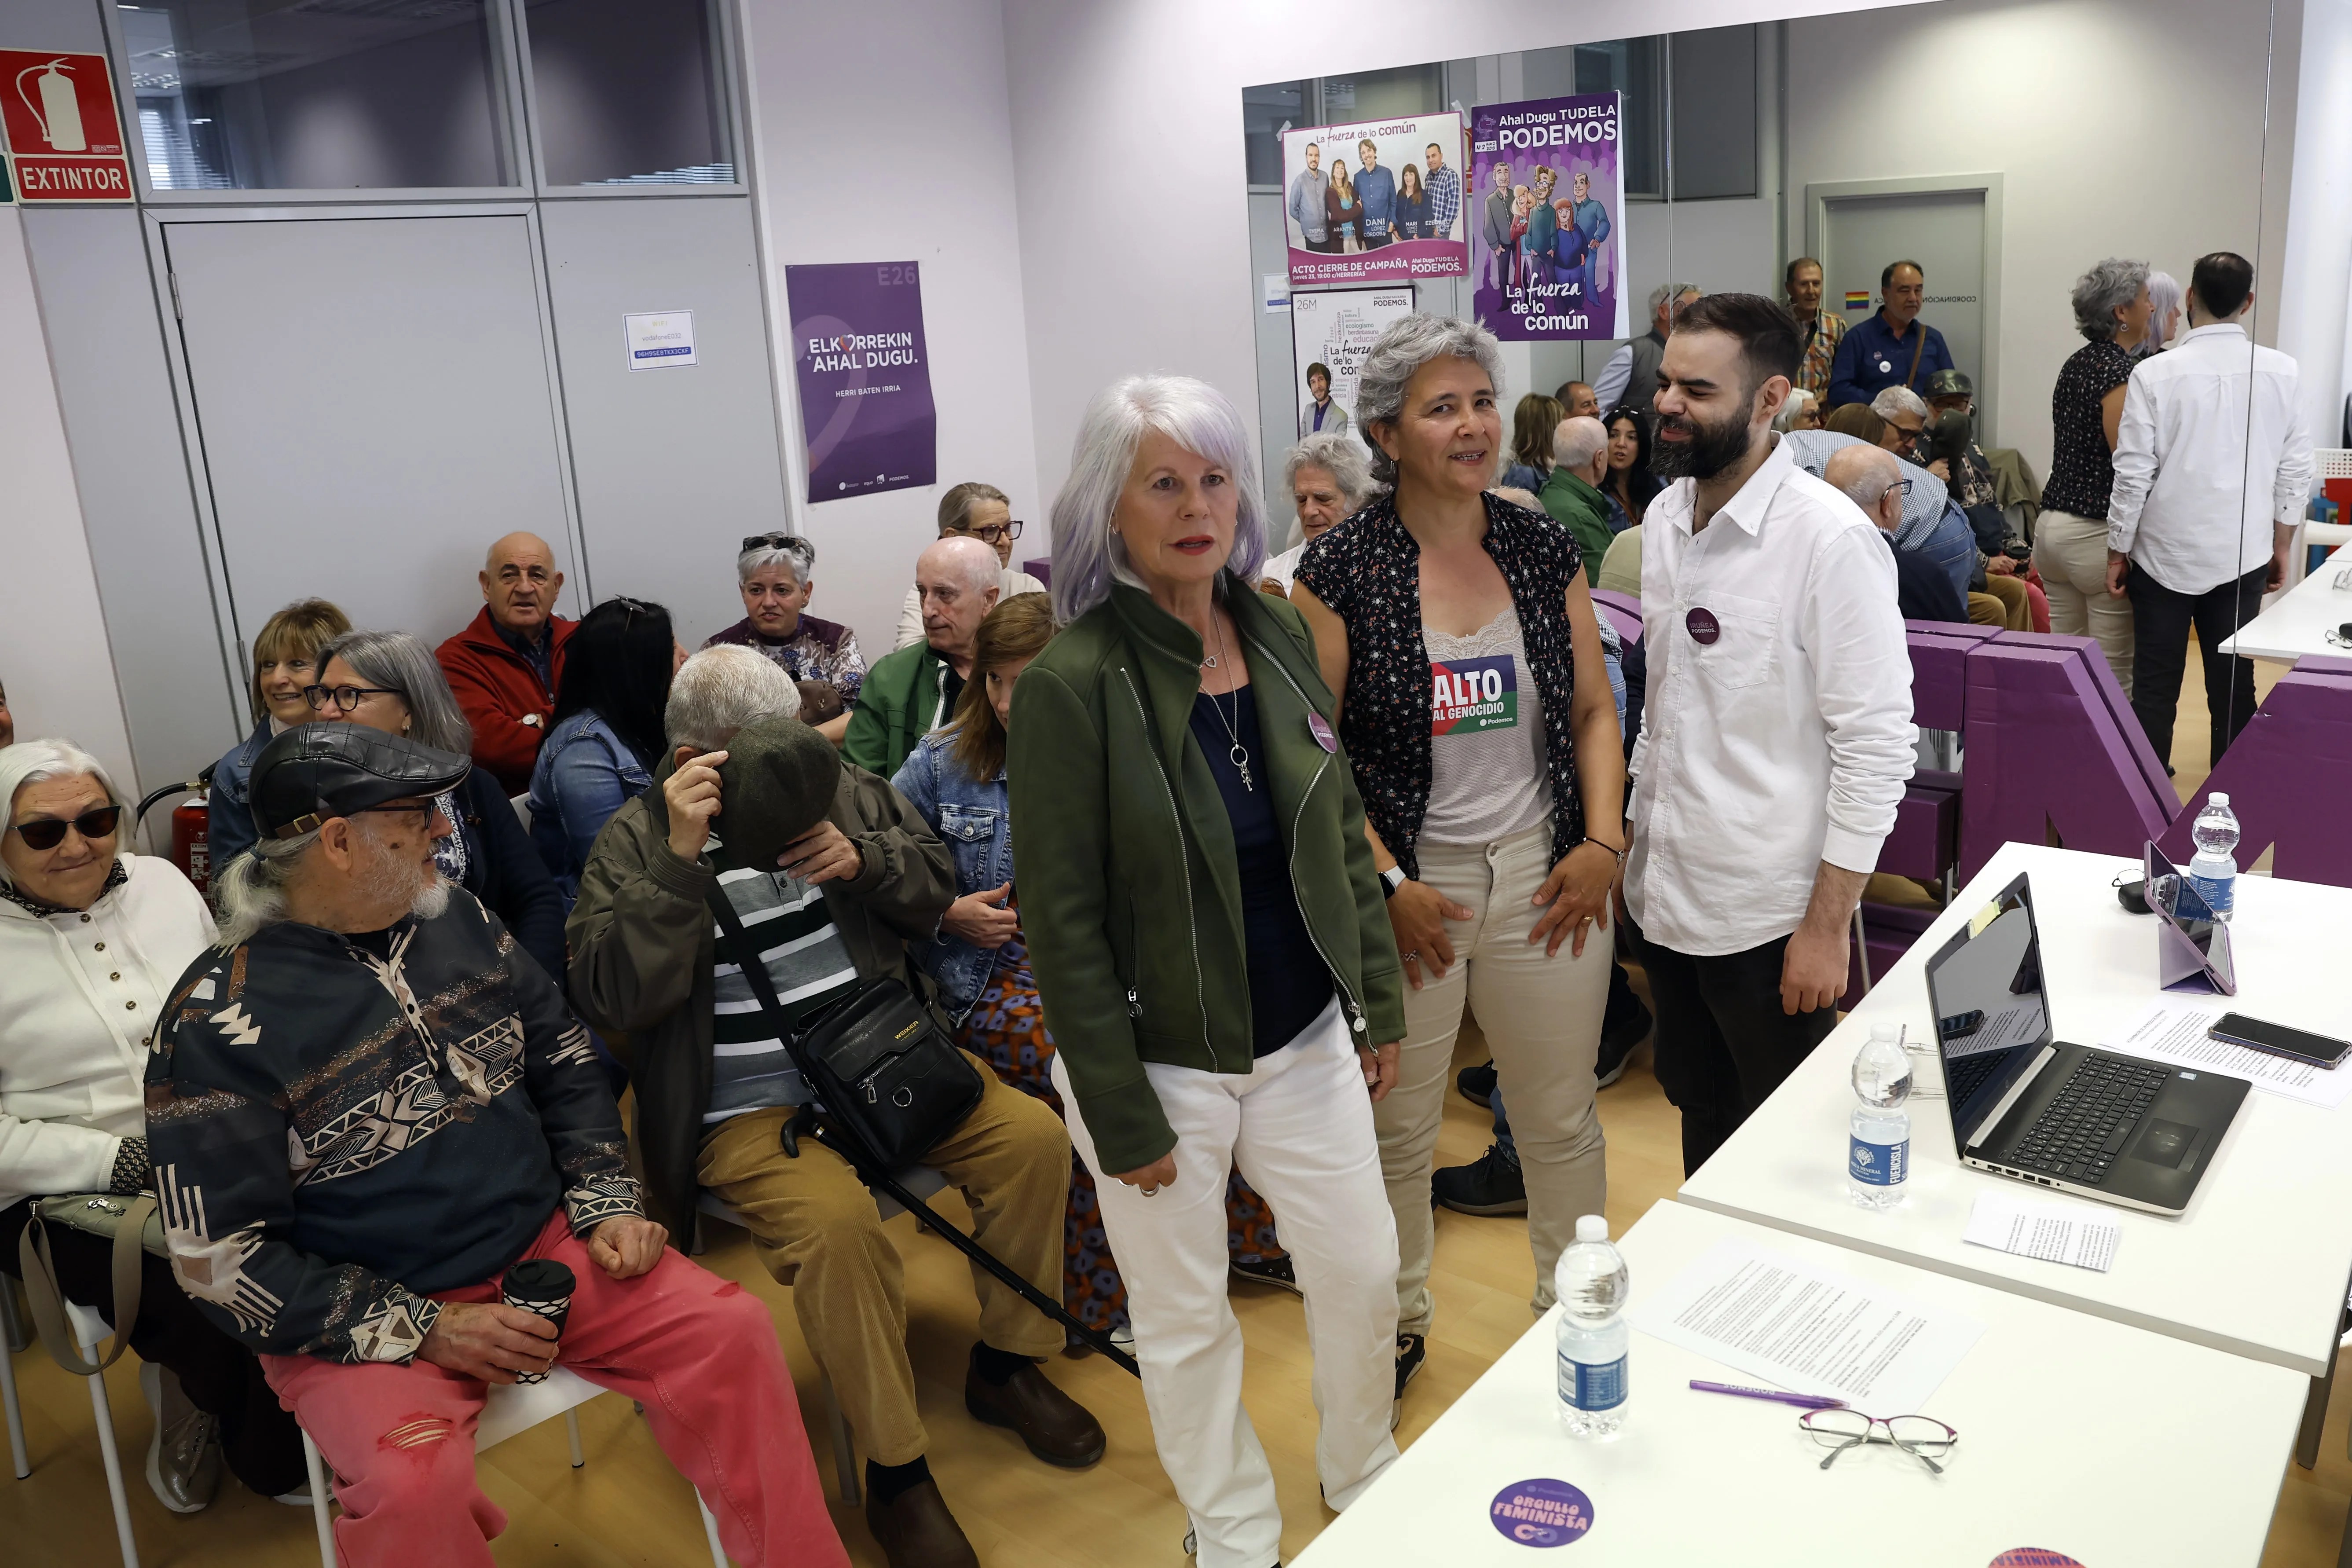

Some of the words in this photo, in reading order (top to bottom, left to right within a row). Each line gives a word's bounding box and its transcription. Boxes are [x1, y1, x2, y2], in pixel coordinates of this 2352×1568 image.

[1499, 114, 1524, 127] Ahal
[1526, 112, 1556, 125] Dugu
[1559, 105, 1616, 121] TUDELA
[1327, 127, 1356, 147] fuerza
[1370, 129, 1376, 137] lo
[1379, 121, 1416, 136] común
[1499, 120, 1616, 150] PODEMOS
[22, 167, 125, 190] EXTINTOR
[877, 266, 916, 286] E26
[1292, 264, 1315, 274] ACTO
[1318, 263, 1348, 273] CIERRE
[1351, 262, 1363, 271] DE
[1364, 258, 1408, 270] CAMPAÑA
[1411, 262, 1462, 273] PODEMOS.
[1506, 285, 1522, 298] La
[1527, 272, 1582, 306] fuerza
[1297, 299, 1317, 310] 26M
[1511, 300, 1529, 314] de
[1533, 300, 1545, 314] lo
[1525, 309, 1588, 331] común
[813, 354, 862, 373] AHAL
[866, 349, 918, 367] DUGU.
[1334, 356, 1343, 365] de
[1345, 356, 1352, 365] lo
[835, 389, 856, 397] HERRI
[858, 387, 880, 396] BATEN
[882, 385, 901, 393] IRRIA
[1433, 669, 1502, 708] ALTO
[1433, 709, 1445, 721] AL
[1448, 702, 1504, 719] GENOCIDIO
[894, 1020, 919, 1039] WEIXIER
[1890, 1144, 1902, 1183] FUENCISLA
[1723, 1385, 1775, 1395] PODEMOS
[1513, 1495, 1580, 1516] ORGULLO
[1493, 1502, 1587, 1531] FEMINISTA
